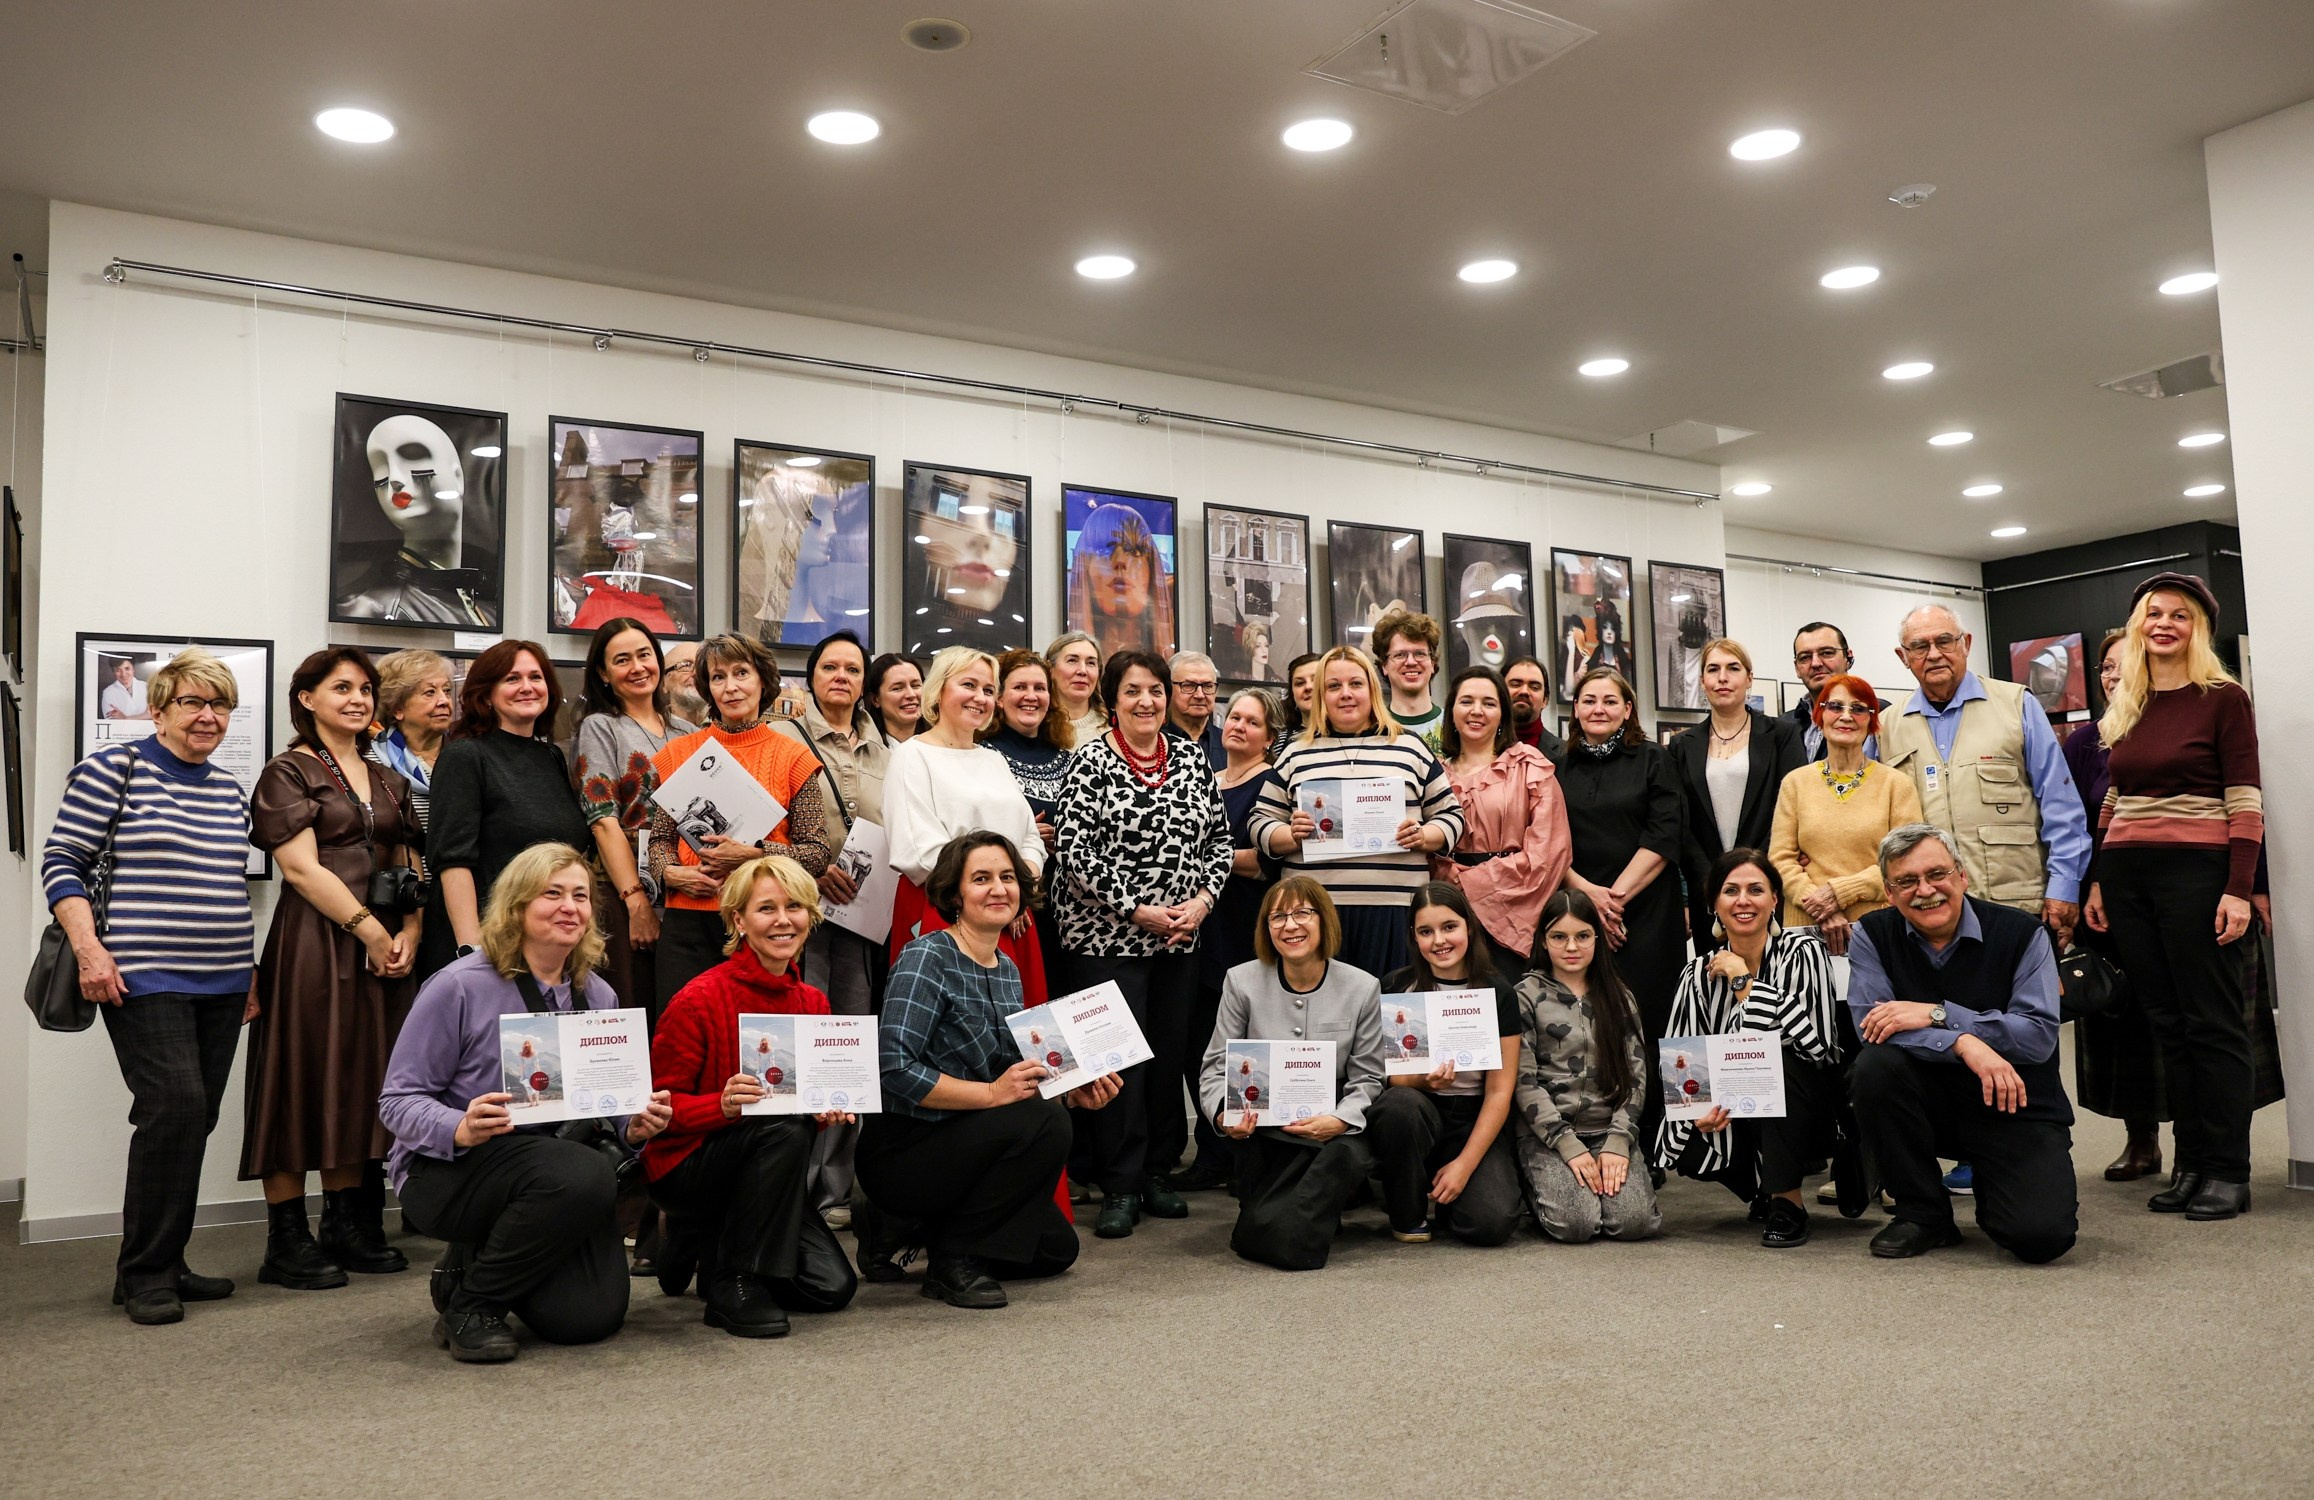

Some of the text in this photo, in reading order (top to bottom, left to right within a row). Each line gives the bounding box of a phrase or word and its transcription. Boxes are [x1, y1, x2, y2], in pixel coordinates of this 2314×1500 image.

[319, 749, 335, 766] EOS
[330, 766, 341, 775] 5D
[1356, 795, 1392, 803] ДИПЛОМ
[1072, 1004, 1109, 1024] ДИПЛОМ
[1442, 1007, 1481, 1017] ДИПЛОМ
[579, 1035, 628, 1048] ДИПЛОМ
[813, 1038, 860, 1048] ДИПЛОМ
[1724, 1051, 1765, 1061] ДИПЛОМ
[1284, 1061, 1321, 1070] ДИПЛОМ
